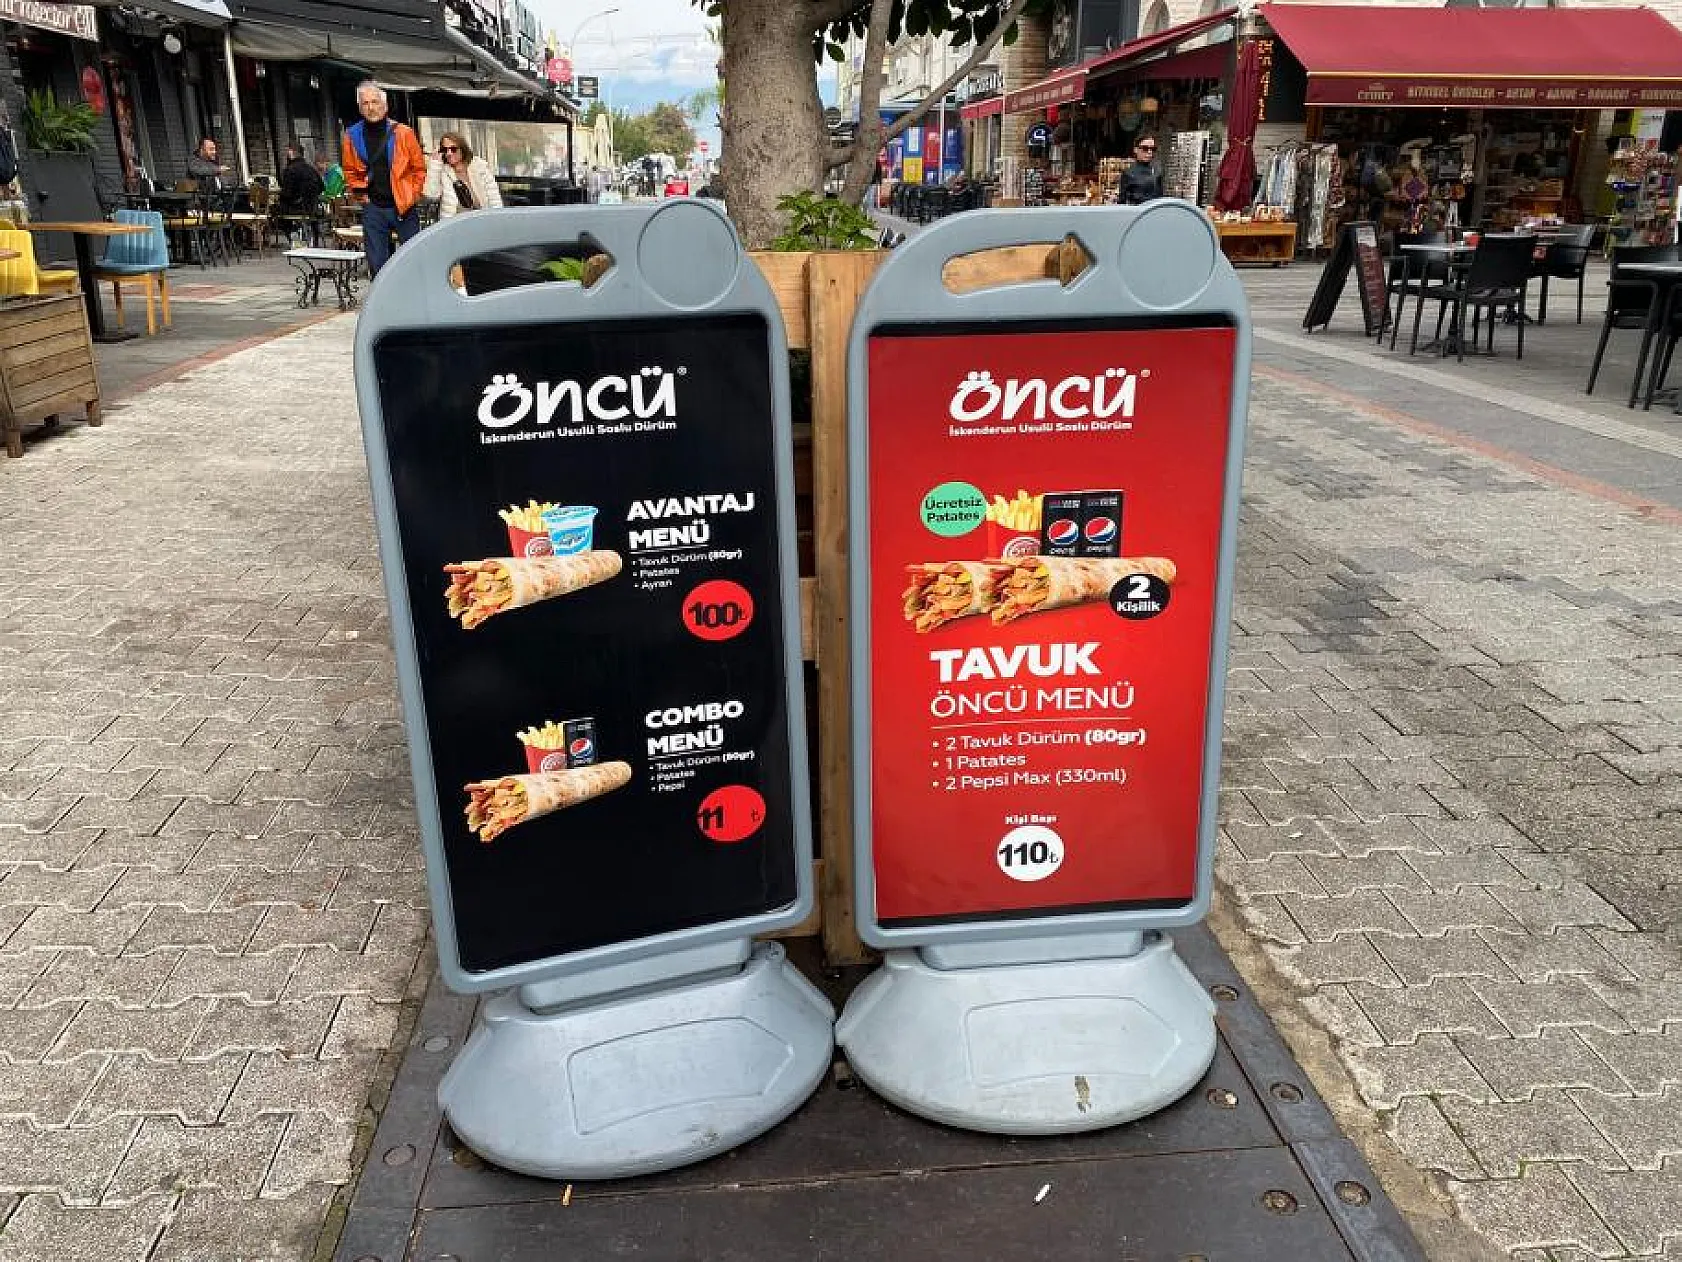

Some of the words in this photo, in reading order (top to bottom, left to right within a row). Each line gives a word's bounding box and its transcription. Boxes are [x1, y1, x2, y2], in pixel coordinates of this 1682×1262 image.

[634, 420, 676, 432] Dürüm
[1091, 420, 1132, 430] Dürüm
[626, 491, 755, 521] AVANTAJ
[925, 496, 983, 510] Ücretsiz
[926, 511, 980, 523] Patates
[628, 518, 710, 549] MENÜ
[671, 553, 707, 564] Dürüm
[640, 568, 680, 578] Patates
[641, 580, 673, 592] Ayran
[1127, 576, 1150, 598] 2
[1117, 601, 1160, 613] Kişilik
[930, 642, 1102, 683] TAVUK
[931, 684, 1028, 717] ÖNCÜ
[1037, 681, 1135, 711] MENÜ
[645, 700, 744, 728] COMBO
[648, 724, 724, 755] MENÜ
[945, 737, 957, 751] 2
[960, 733, 1012, 750] Tavuk
[1018, 731, 1080, 746] Dürüm
[1085, 728, 1146, 746] (80gr)
[687, 756, 721, 766] Dürüm
[945, 756, 952, 770] 1
[957, 754, 1027, 770] Patates
[656, 770, 695, 782] Patates
[945, 776, 957, 790] 2
[961, 771, 1009, 790] Pepsi
[1013, 771, 1050, 786] Max
[1056, 768, 1127, 786] (330ml)
[658, 780, 685, 792] Pepsi
